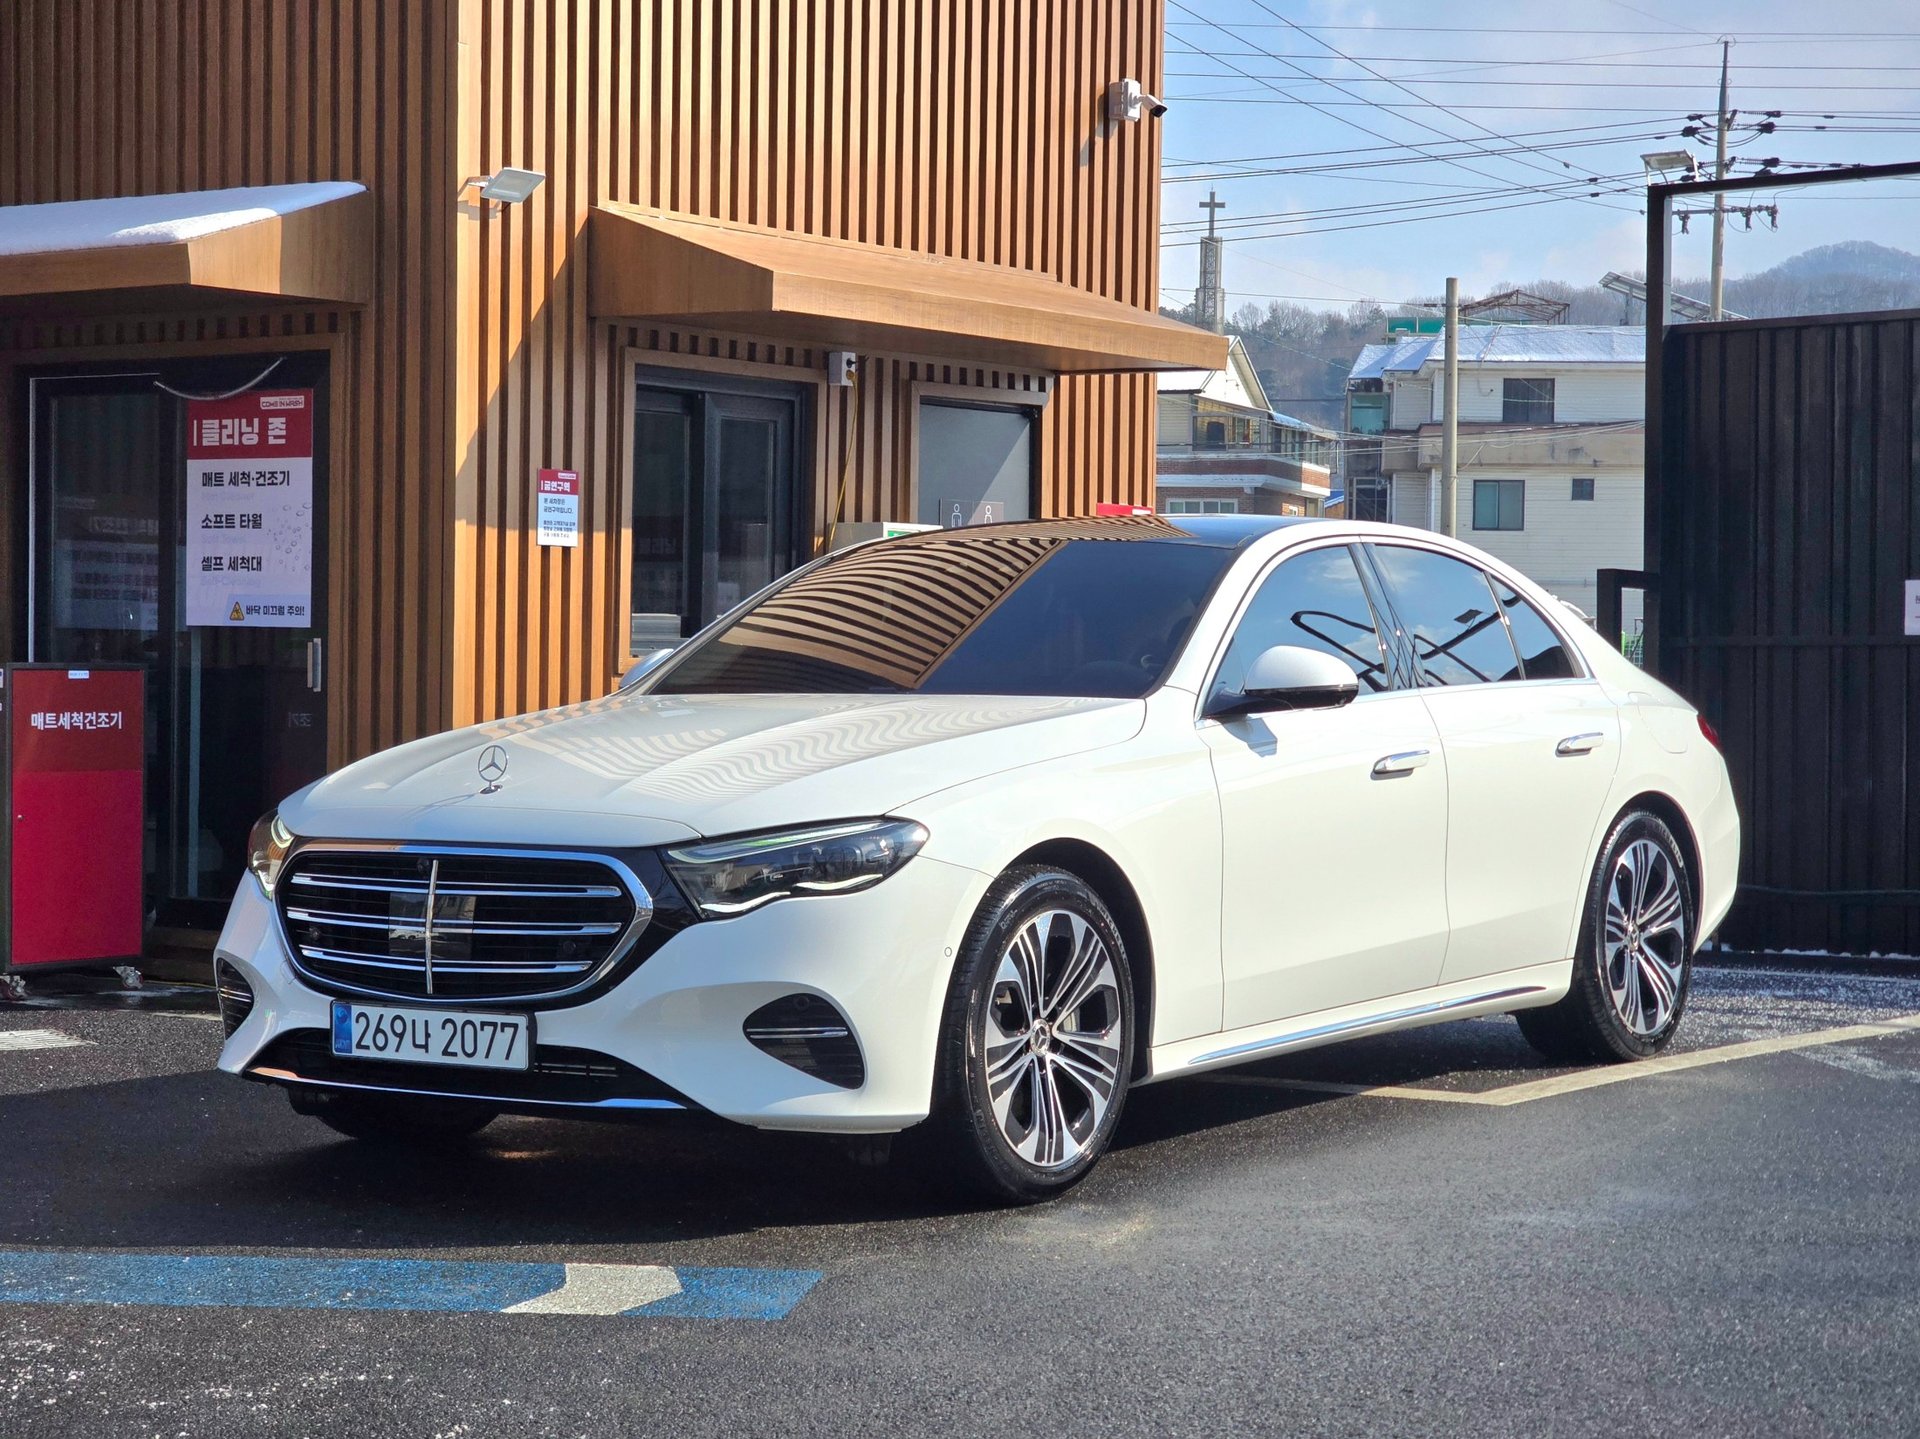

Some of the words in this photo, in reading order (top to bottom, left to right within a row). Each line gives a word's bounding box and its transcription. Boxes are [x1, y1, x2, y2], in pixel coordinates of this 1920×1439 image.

[202, 418, 259, 446] 클리닝
[267, 417, 286, 444] 존
[201, 471, 225, 487] 매트
[201, 514, 236, 529] 소프트
[239, 513, 263, 529] 타월
[201, 556, 224, 572] 셀프
[227, 556, 263, 572] 세척대
[245, 605, 261, 616] 바닥
[262, 605, 285, 616] 미끄럼
[287, 605, 305, 616] 주의!
[31, 711, 122, 730] 매트세척건조기
[355, 1011, 432, 1054] 269나
[441, 1017, 519, 1060] 2077
